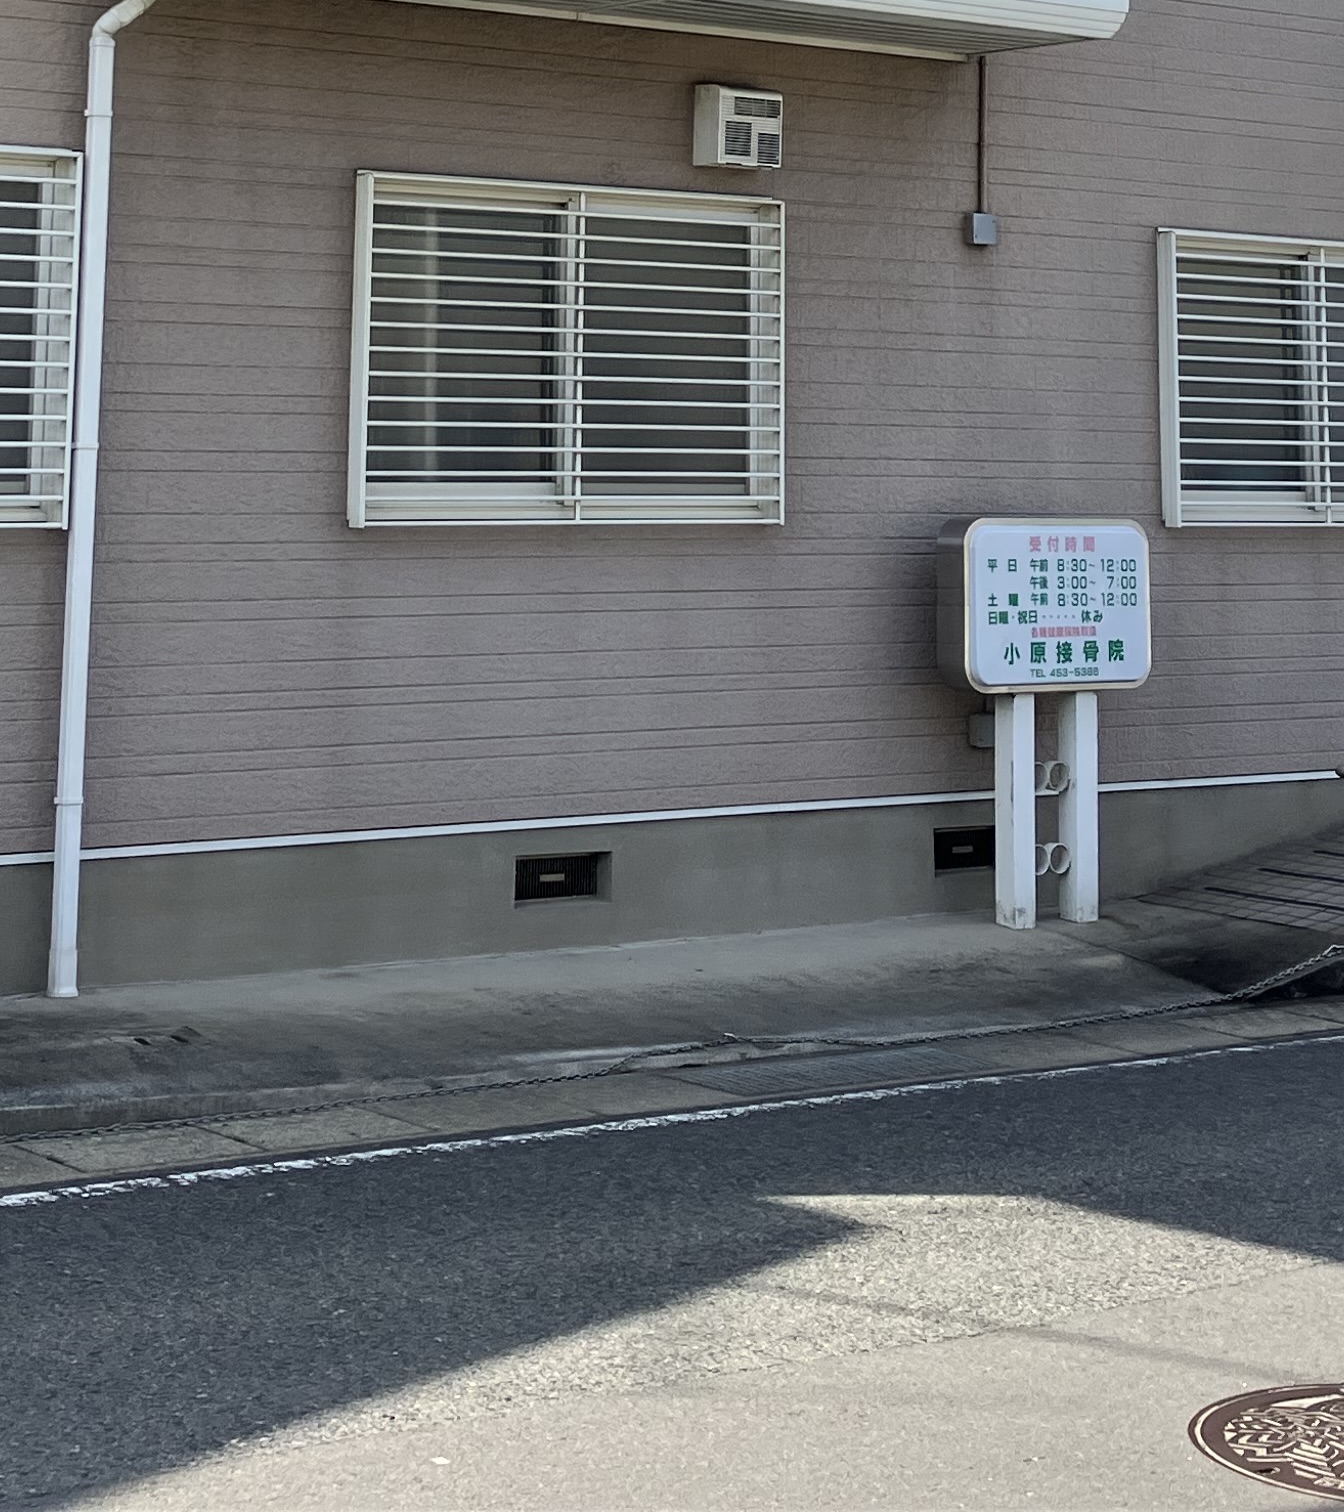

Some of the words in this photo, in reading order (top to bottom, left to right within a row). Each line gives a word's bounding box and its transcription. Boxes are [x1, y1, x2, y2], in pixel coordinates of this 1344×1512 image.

[1030, 536, 1095, 552] 受付時間
[1004, 639, 1124, 665] 小原接骨院
[1030, 669, 1046, 678] TEL
